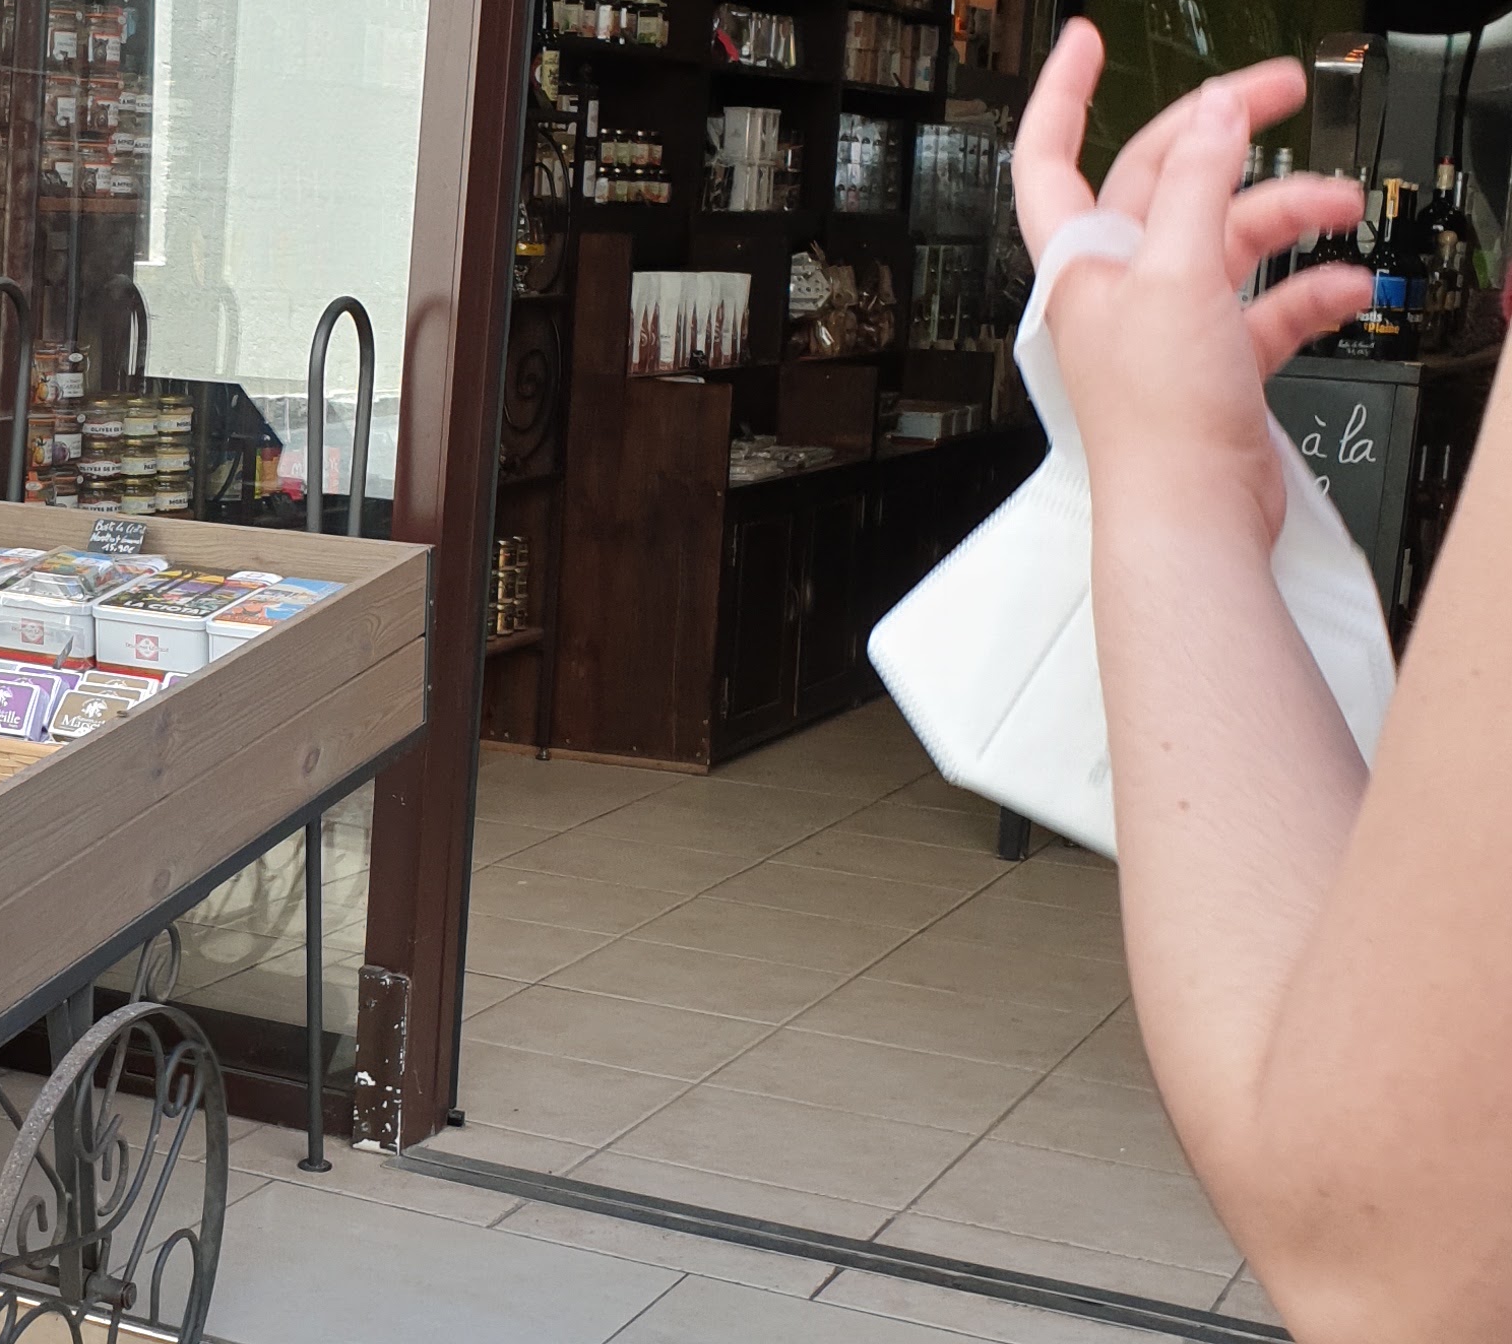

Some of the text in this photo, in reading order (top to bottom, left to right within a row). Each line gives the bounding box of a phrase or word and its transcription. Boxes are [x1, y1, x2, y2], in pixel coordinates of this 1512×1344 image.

[1301, 403, 1377, 464] à la
[151, 603, 212, 617] CIOTAT
